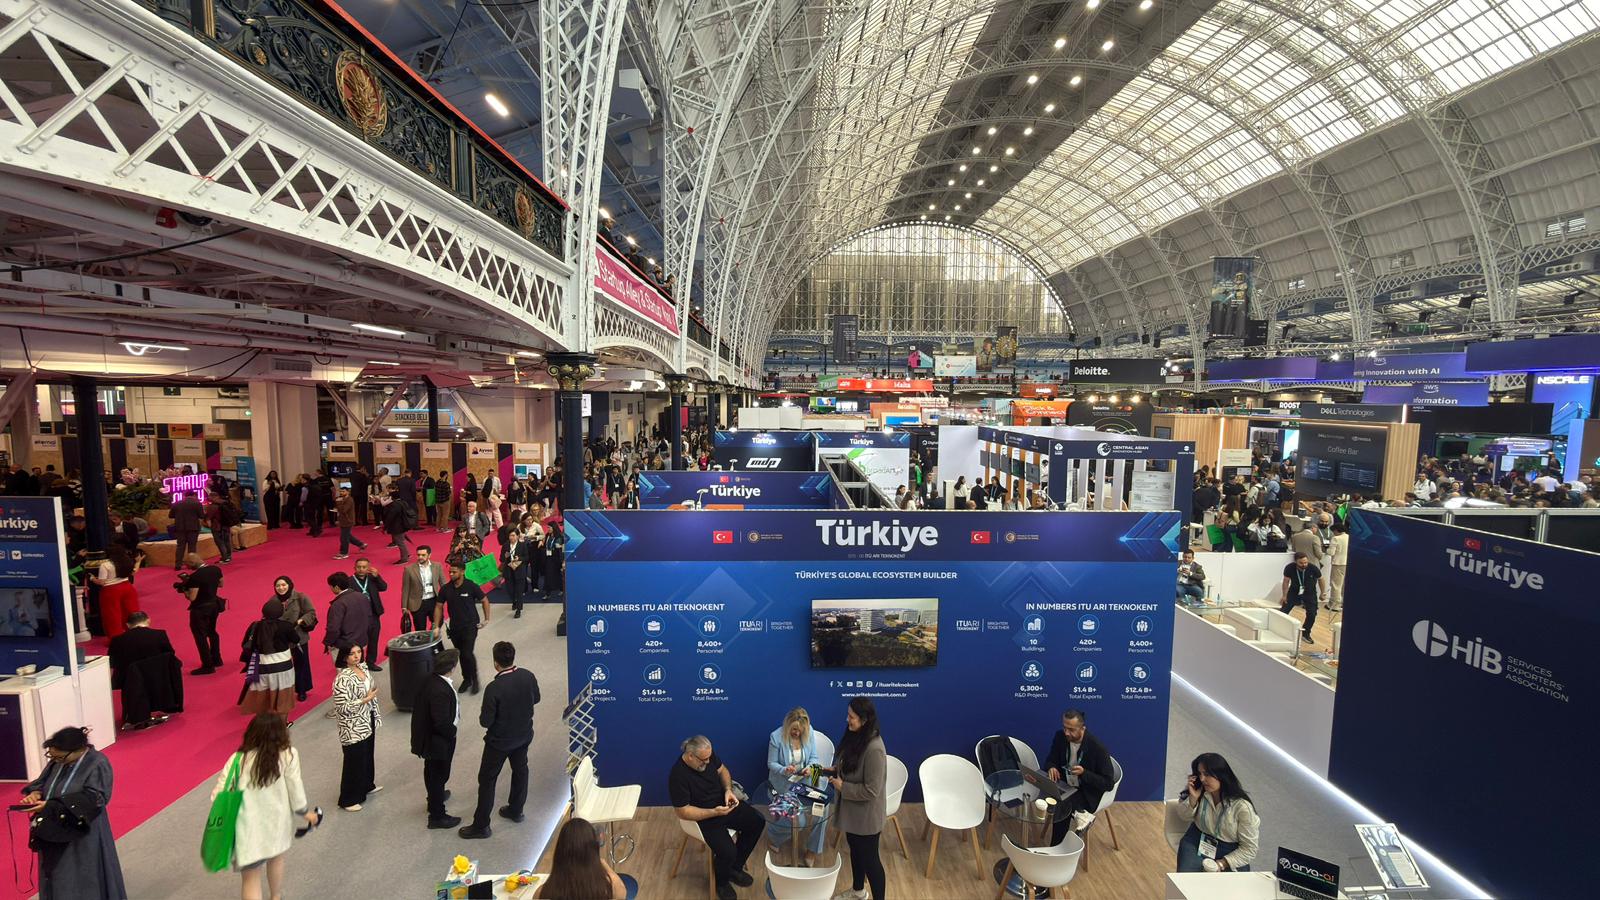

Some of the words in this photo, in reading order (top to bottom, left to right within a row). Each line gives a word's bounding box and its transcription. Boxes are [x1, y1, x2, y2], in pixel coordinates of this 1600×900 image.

[1537, 376, 1589, 385] NSCALE
[394, 413, 416, 421] STACKED
[1321, 407, 1337, 415] DELL
[1337, 408, 1375, 418] Technologies
[752, 437, 777, 446] Türkiye
[850, 438, 874, 446] Türkiye
[1327, 445, 1347, 454] Coffee
[1347, 447, 1360, 455] Bar
[162, 473, 209, 494] STARTUP
[709, 484, 761, 499] Türkiye
[0, 516, 39, 531] rkiye
[815, 519, 939, 552] Türkiye
[1446, 548, 1545, 590] Türkiye
[795, 570, 837, 579] TÜRKİYE'S
[587, 604, 596, 612] IN
[598, 604, 640, 612] NUMBERS
[657, 603, 672, 611] ARI
[673, 603, 726, 611] TEKNOKENT
[1036, 603, 1077, 611] NUMBERS
[1078, 603, 1092, 611] ITU
[698, 640, 722, 648] 8,400+
[1507, 655, 1553, 678] SERVICES
[1505, 673, 1569, 703] ASSOCIATION
